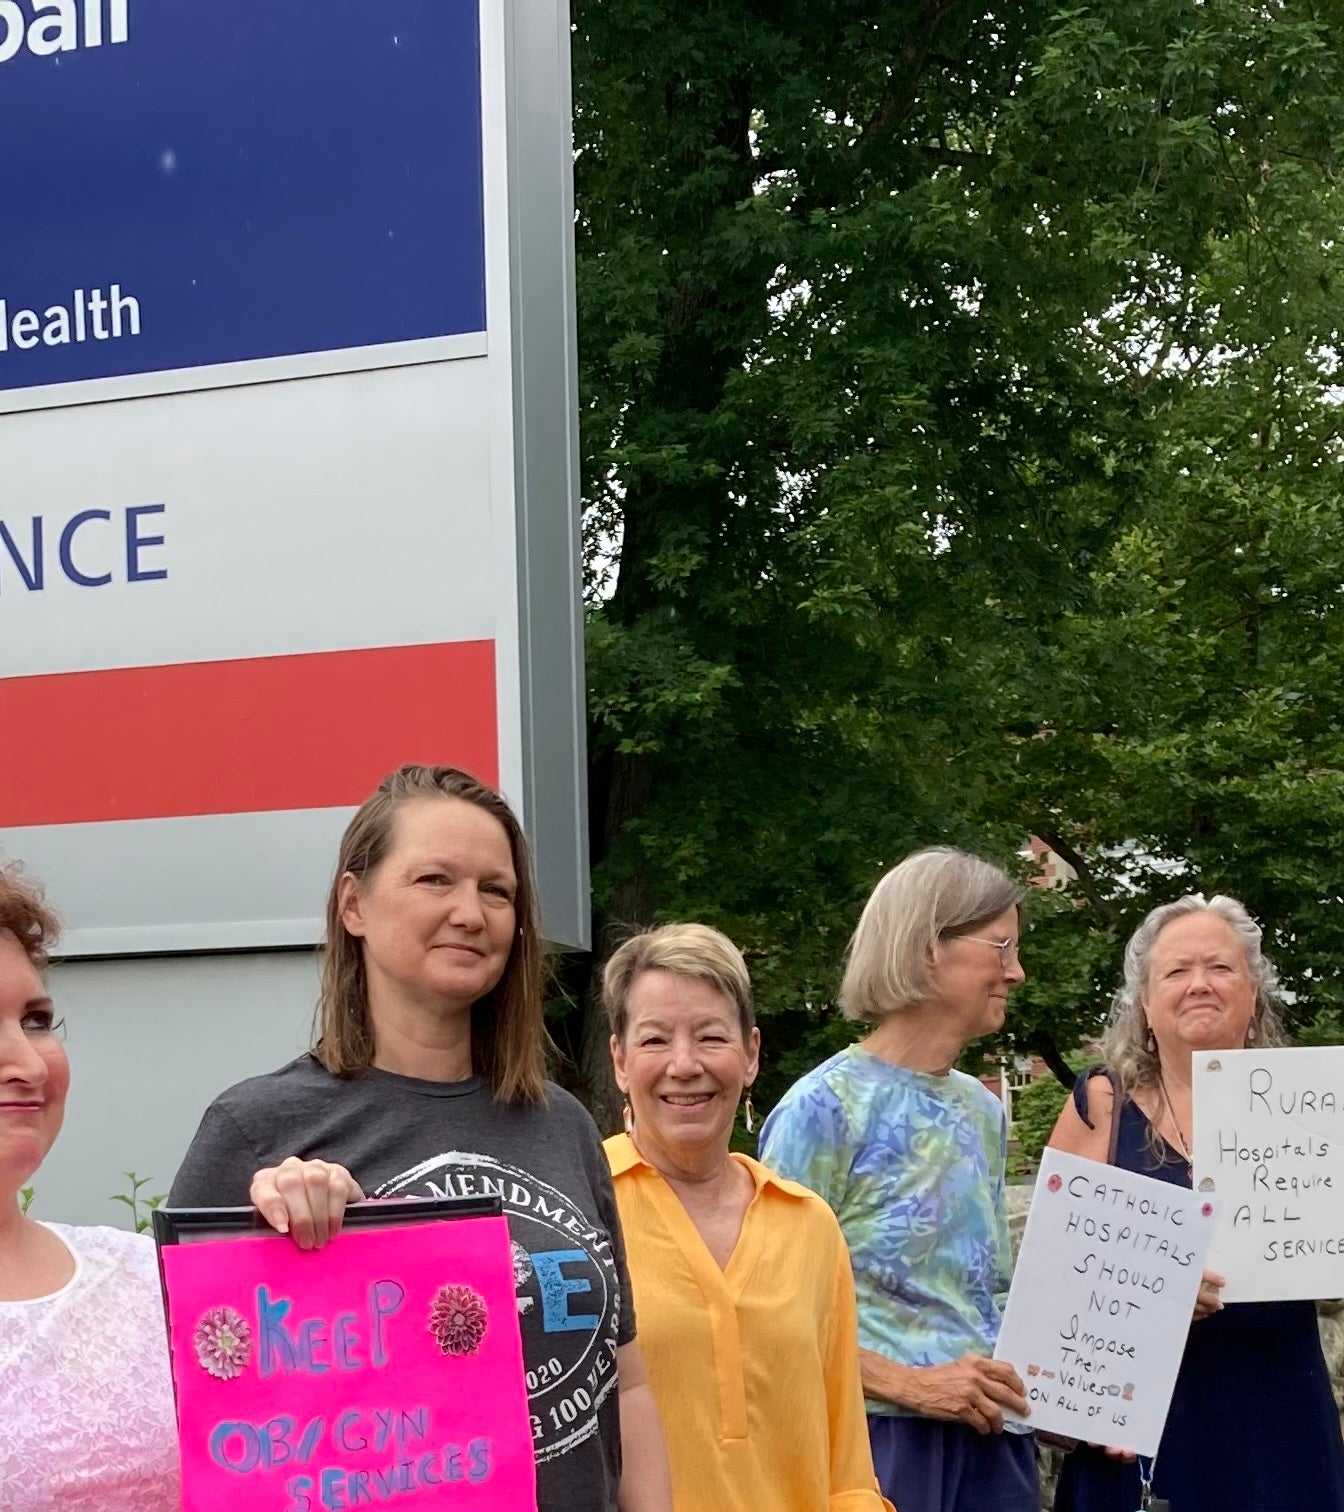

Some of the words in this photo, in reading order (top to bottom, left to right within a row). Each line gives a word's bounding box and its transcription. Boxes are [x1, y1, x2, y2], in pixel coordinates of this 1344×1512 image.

[1218, 1130, 1330, 1166] Hospitals
[1253, 1164, 1333, 1196] Require
[1068, 1175, 1184, 1226] CATHOLIC
[1233, 1205, 1301, 1227] ALL
[1065, 1211, 1196, 1266] HOSPITALS
[1072, 1253, 1165, 1294] SHOULD
[1088, 1290, 1141, 1319] NOT
[257, 1279, 406, 1378] KEEP
[1059, 1314, 1135, 1359] Impose
[526, 1357, 563, 1391] 020
[1060, 1346, 1106, 1375] Their
[1059, 1370, 1107, 1396] Values
[549, 1386, 592, 1431] 100
[1029, 1388, 1050, 1403] ON
[1056, 1396, 1078, 1412] ALL
[1087, 1405, 1102, 1417] OF
[1112, 1412, 1127, 1426] US
